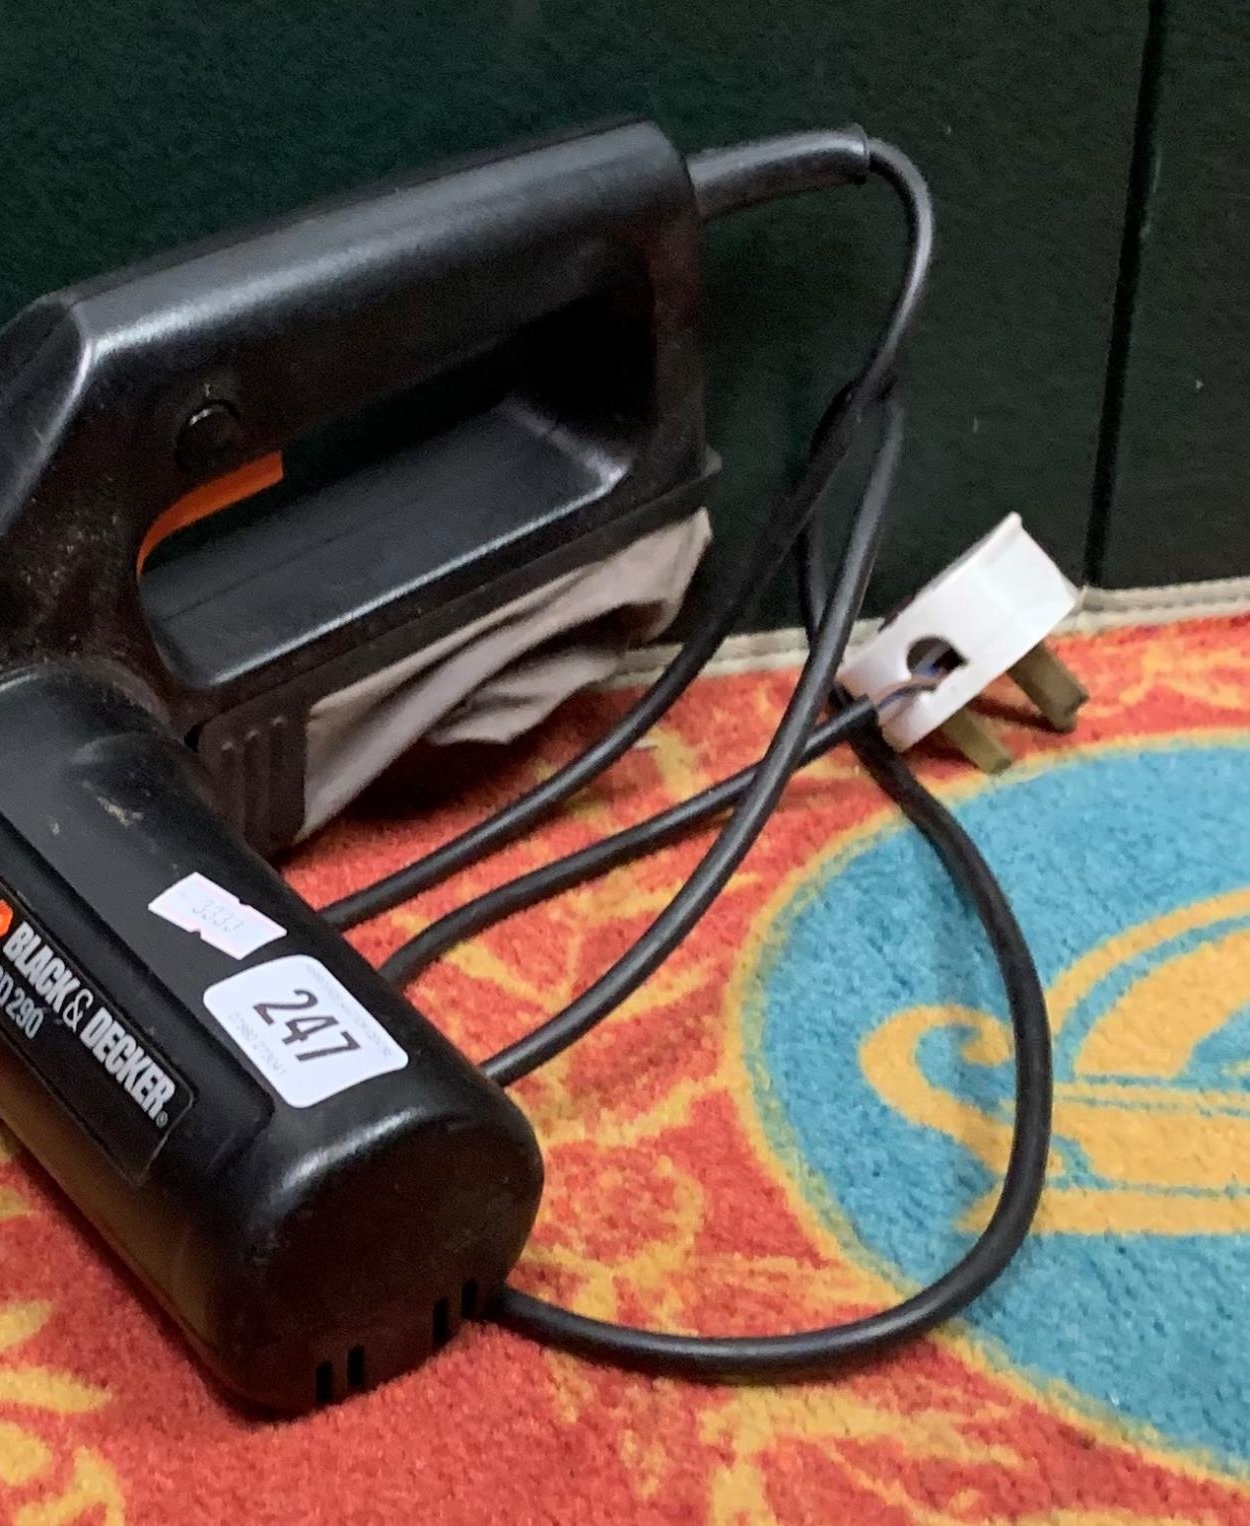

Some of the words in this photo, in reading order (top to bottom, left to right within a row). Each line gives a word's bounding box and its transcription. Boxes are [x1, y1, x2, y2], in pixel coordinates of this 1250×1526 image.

[3, 920, 80, 1013] BLACK
[63, 987, 93, 1032] &
[253, 988, 361, 1063] 247
